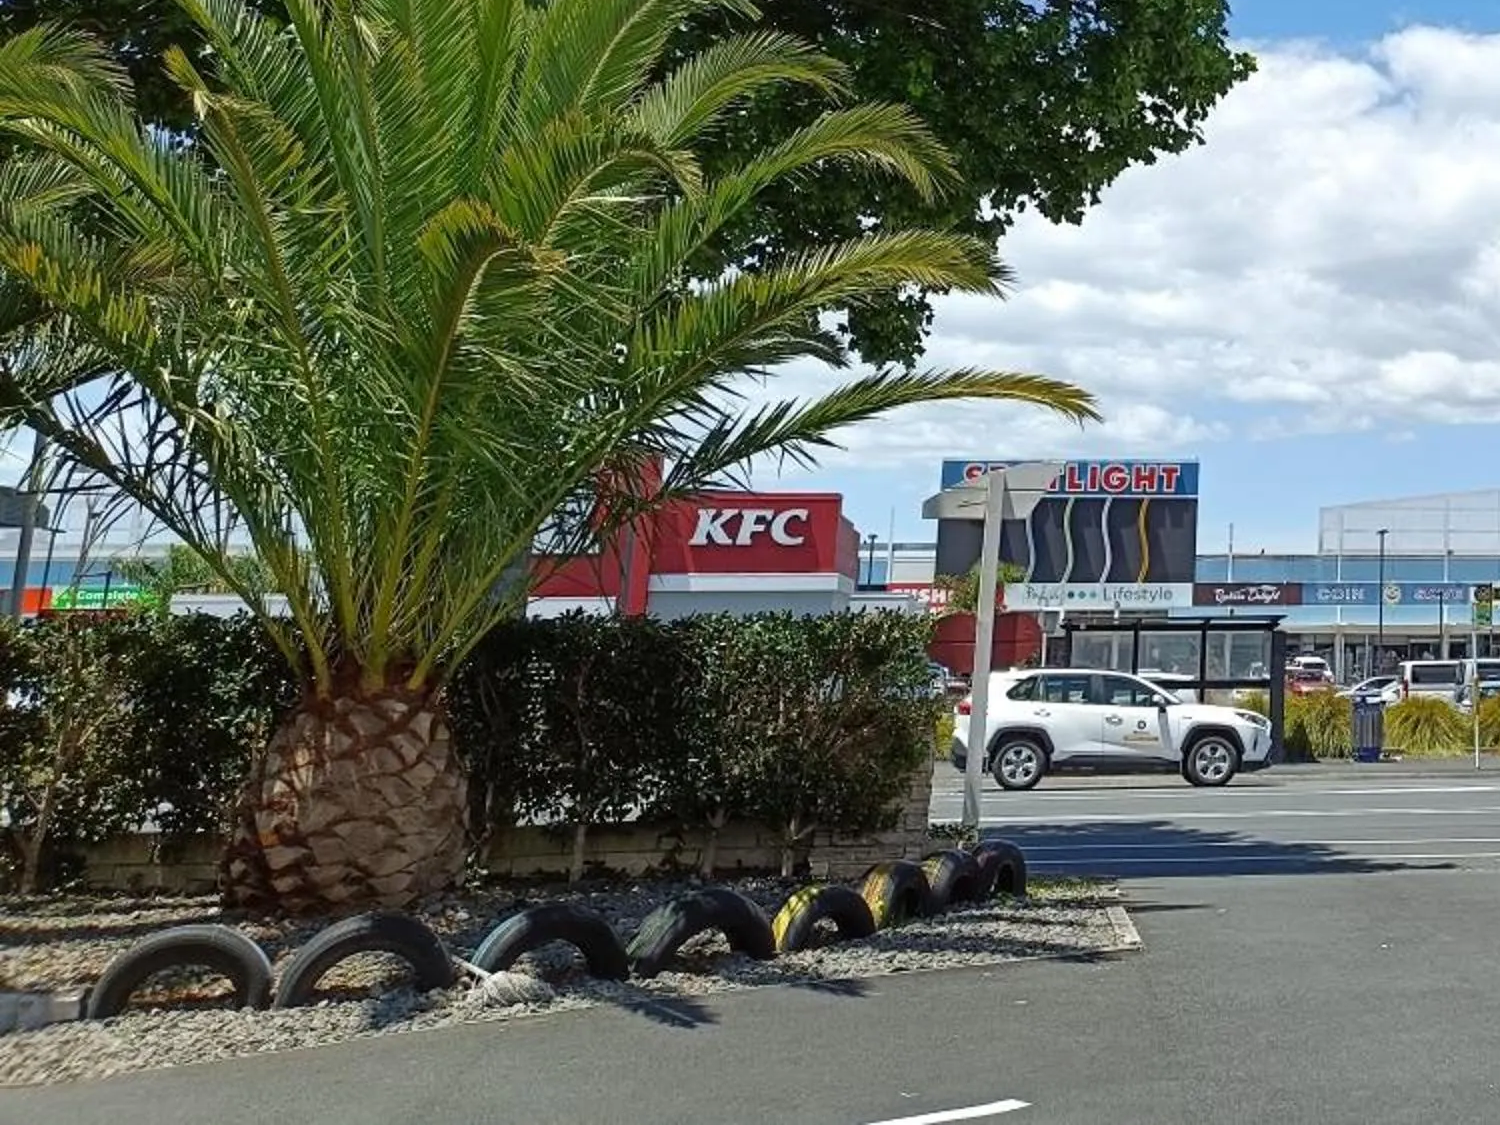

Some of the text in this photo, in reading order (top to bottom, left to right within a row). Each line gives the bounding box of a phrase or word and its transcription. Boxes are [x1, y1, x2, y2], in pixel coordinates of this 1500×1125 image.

[963, 464, 1181, 492] SLIGHT
[688, 508, 809, 546] KFC
[1103, 586, 1173, 604] Lifestyle
